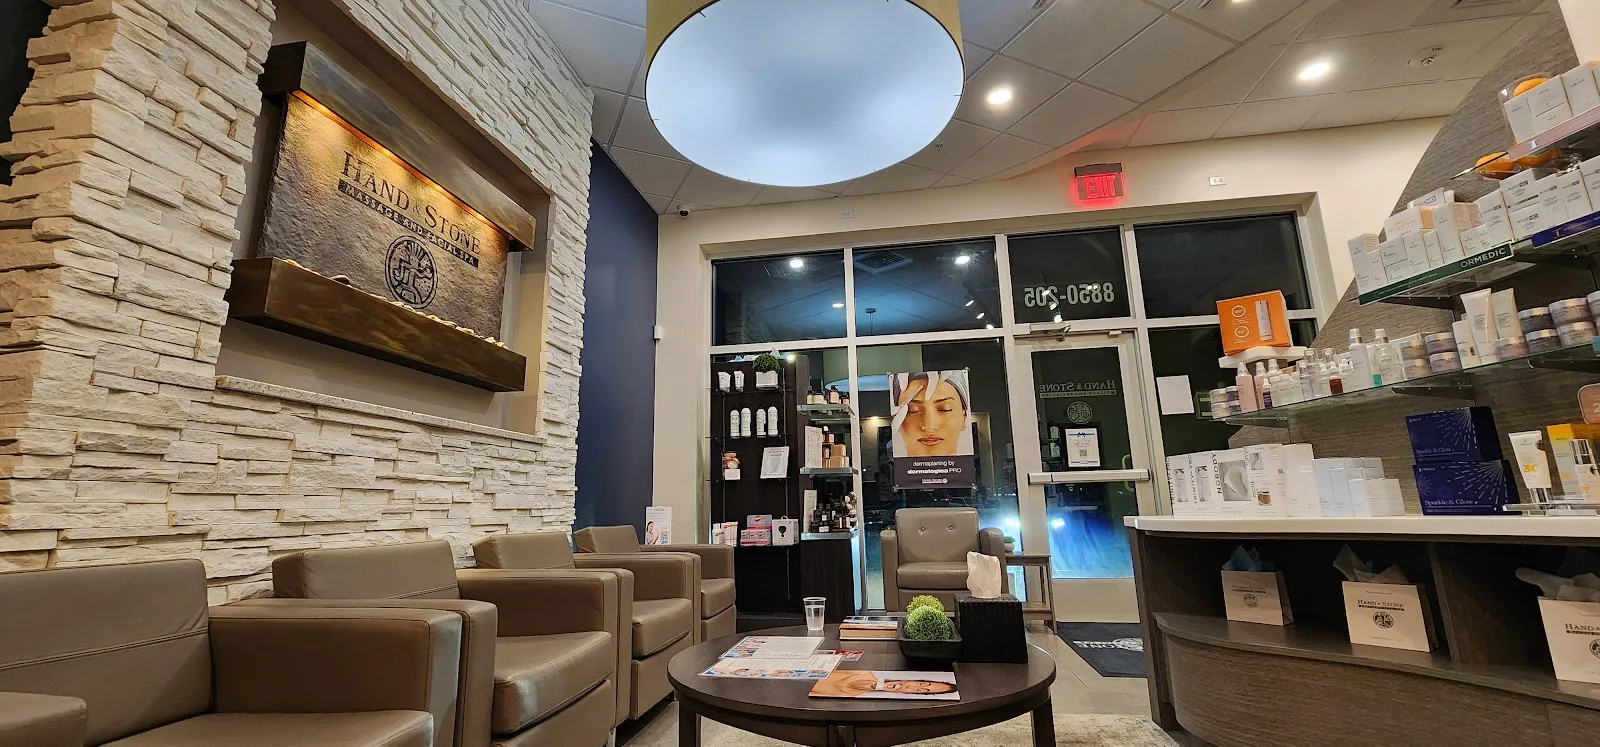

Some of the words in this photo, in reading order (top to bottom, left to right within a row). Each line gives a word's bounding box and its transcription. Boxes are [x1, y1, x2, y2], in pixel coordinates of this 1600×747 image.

[1084, 175, 1116, 199] EXIT
[412, 202, 421, 216] &
[345, 184, 400, 222] MASSAGE
[403, 217, 425, 236] AND
[427, 230, 458, 257] FACIAL
[459, 251, 476, 267] SPA
[1460, 247, 1506, 268] ORMEDIC
[1424, 499, 1447, 507] Sparkle
[1565, 623, 1594, 631] HAND
